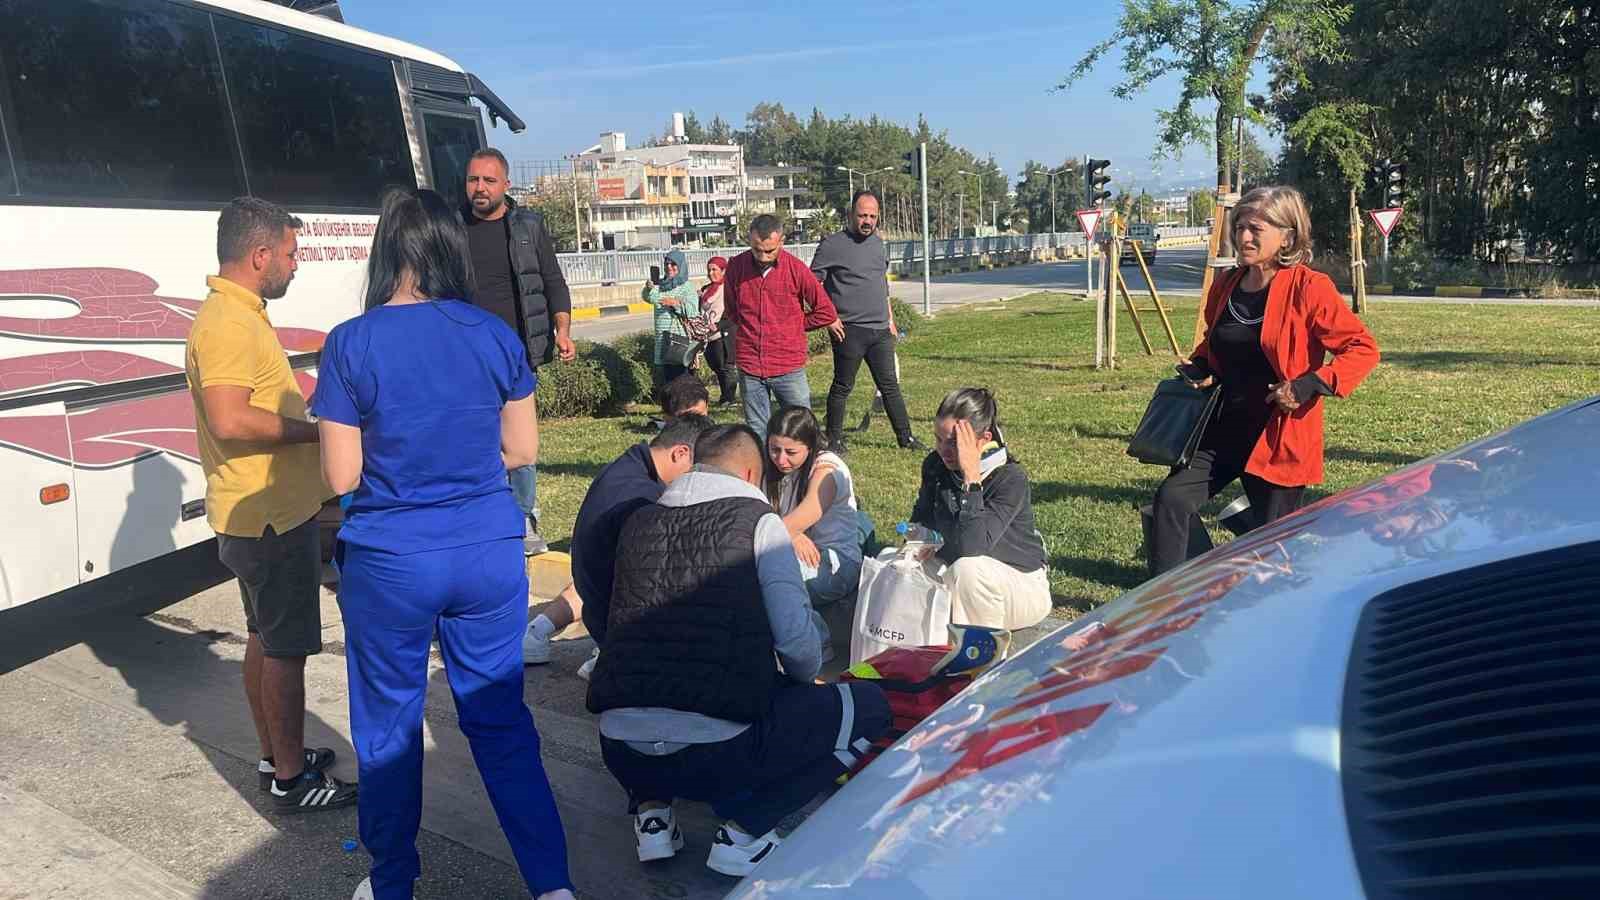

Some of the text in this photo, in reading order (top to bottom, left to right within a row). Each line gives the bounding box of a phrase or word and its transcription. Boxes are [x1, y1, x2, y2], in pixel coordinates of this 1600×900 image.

[352, 219, 377, 238] BELEDİY
[296, 242, 369, 264] NETİMLİ TOPLU TAŞIMA
